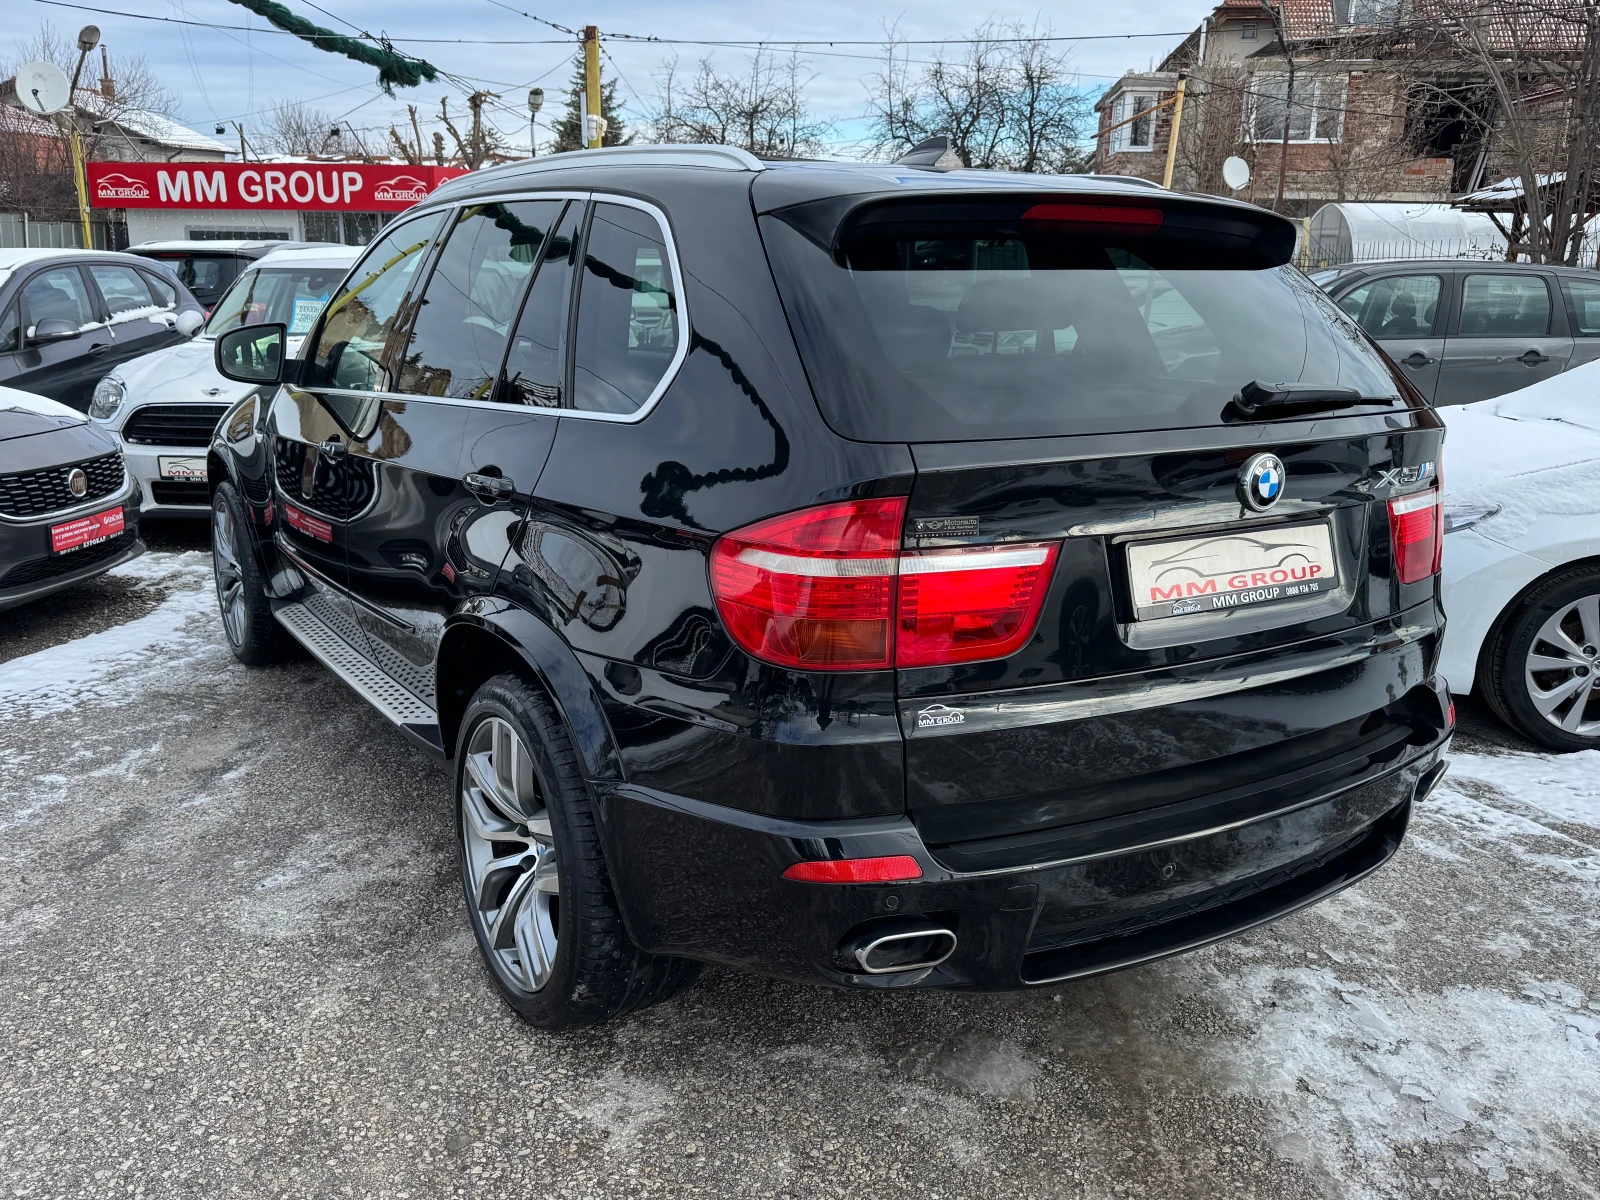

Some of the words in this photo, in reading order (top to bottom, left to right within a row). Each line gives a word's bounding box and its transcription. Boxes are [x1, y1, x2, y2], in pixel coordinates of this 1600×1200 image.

[117, 189, 150, 197] GROUP
[156, 170, 228, 203] MM
[237, 170, 363, 204] GROUP
[395, 192, 428, 200] GROUP
[1255, 460, 1282, 476] BMW
[1150, 579, 1217, 601] MM
[1227, 564, 1322, 589] GROUP
[1212, 593, 1238, 608] MM
[1240, 587, 1280, 603] GROUP
[936, 714, 964, 724] GROUP
